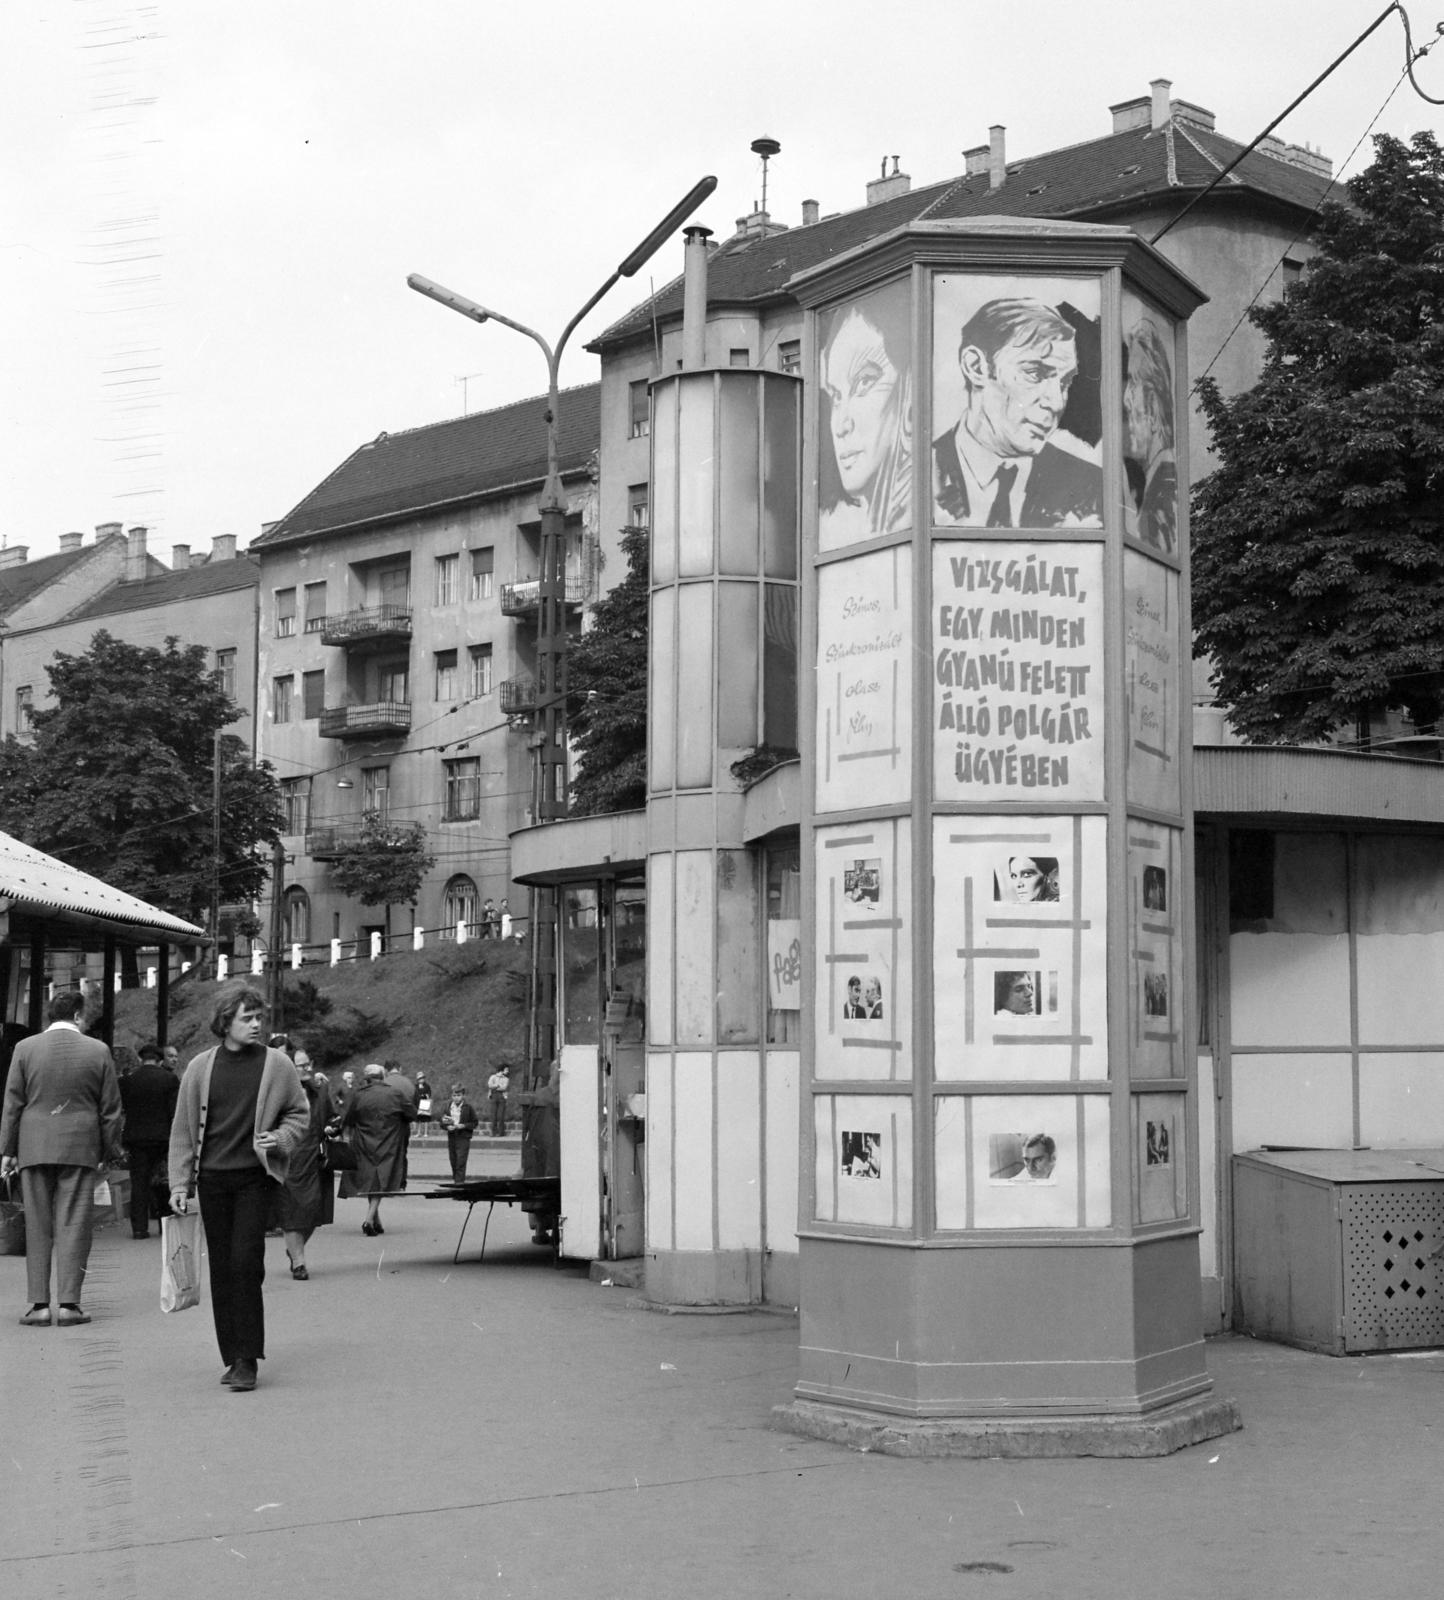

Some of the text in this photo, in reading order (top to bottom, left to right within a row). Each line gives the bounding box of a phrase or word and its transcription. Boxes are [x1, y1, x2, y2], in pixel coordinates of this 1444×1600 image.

[950, 554, 1086, 604] VIZSGÁLAT,
[940, 605, 1085, 649] EGY MINDEN
[936, 648, 1091, 698] GYANÚ FELETT
[939, 690, 1093, 745] ÁLLÓ POLGÁR
[955, 741, 1069, 788] ÜGYÉBEN
